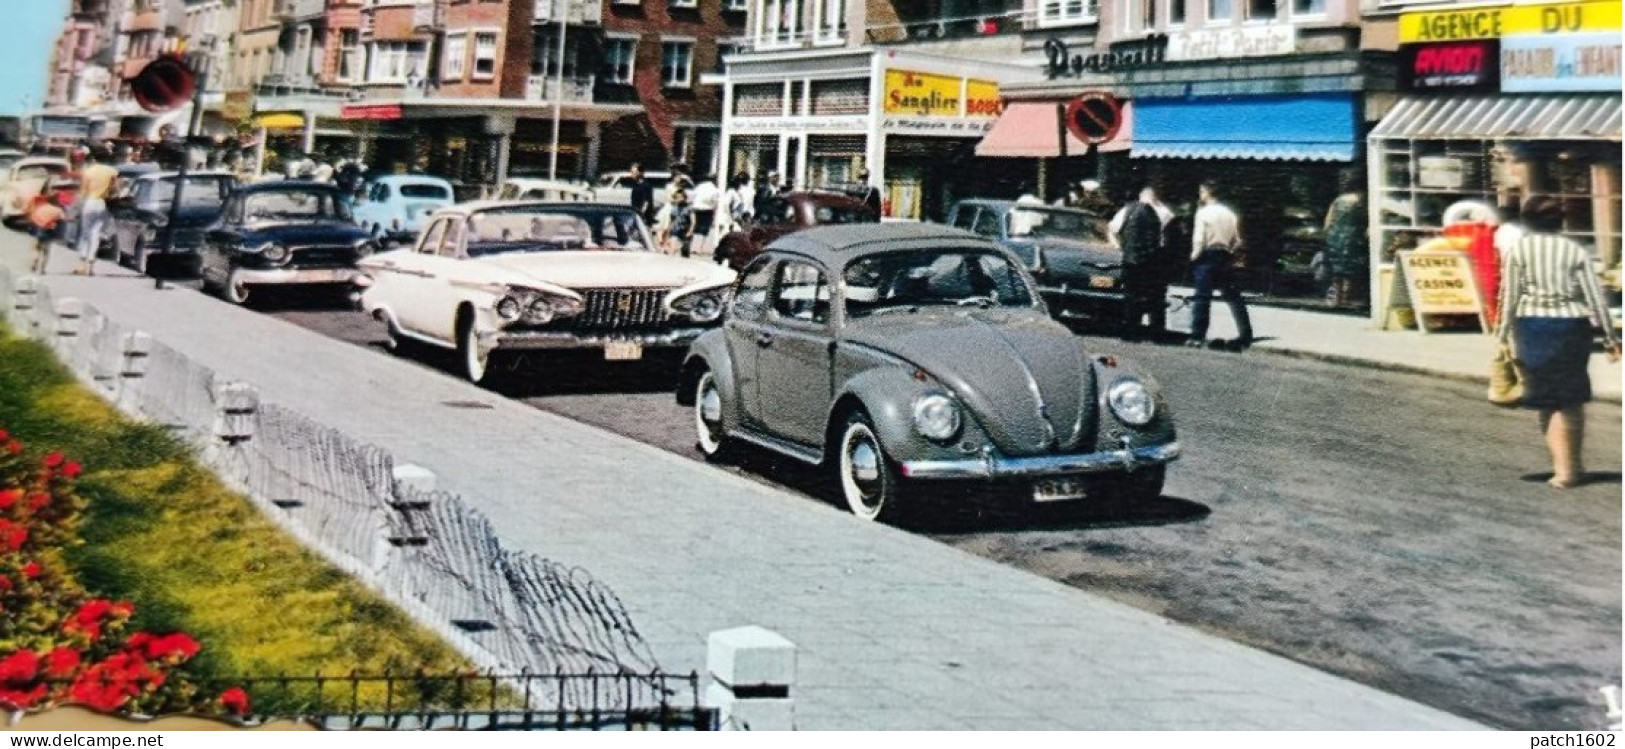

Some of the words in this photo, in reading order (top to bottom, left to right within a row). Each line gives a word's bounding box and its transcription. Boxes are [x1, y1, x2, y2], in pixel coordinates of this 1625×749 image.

[1417, 11, 1501, 40] AGENCE
[1541, 6, 1583, 34] DU
[889, 88, 958, 115] Sanglier
